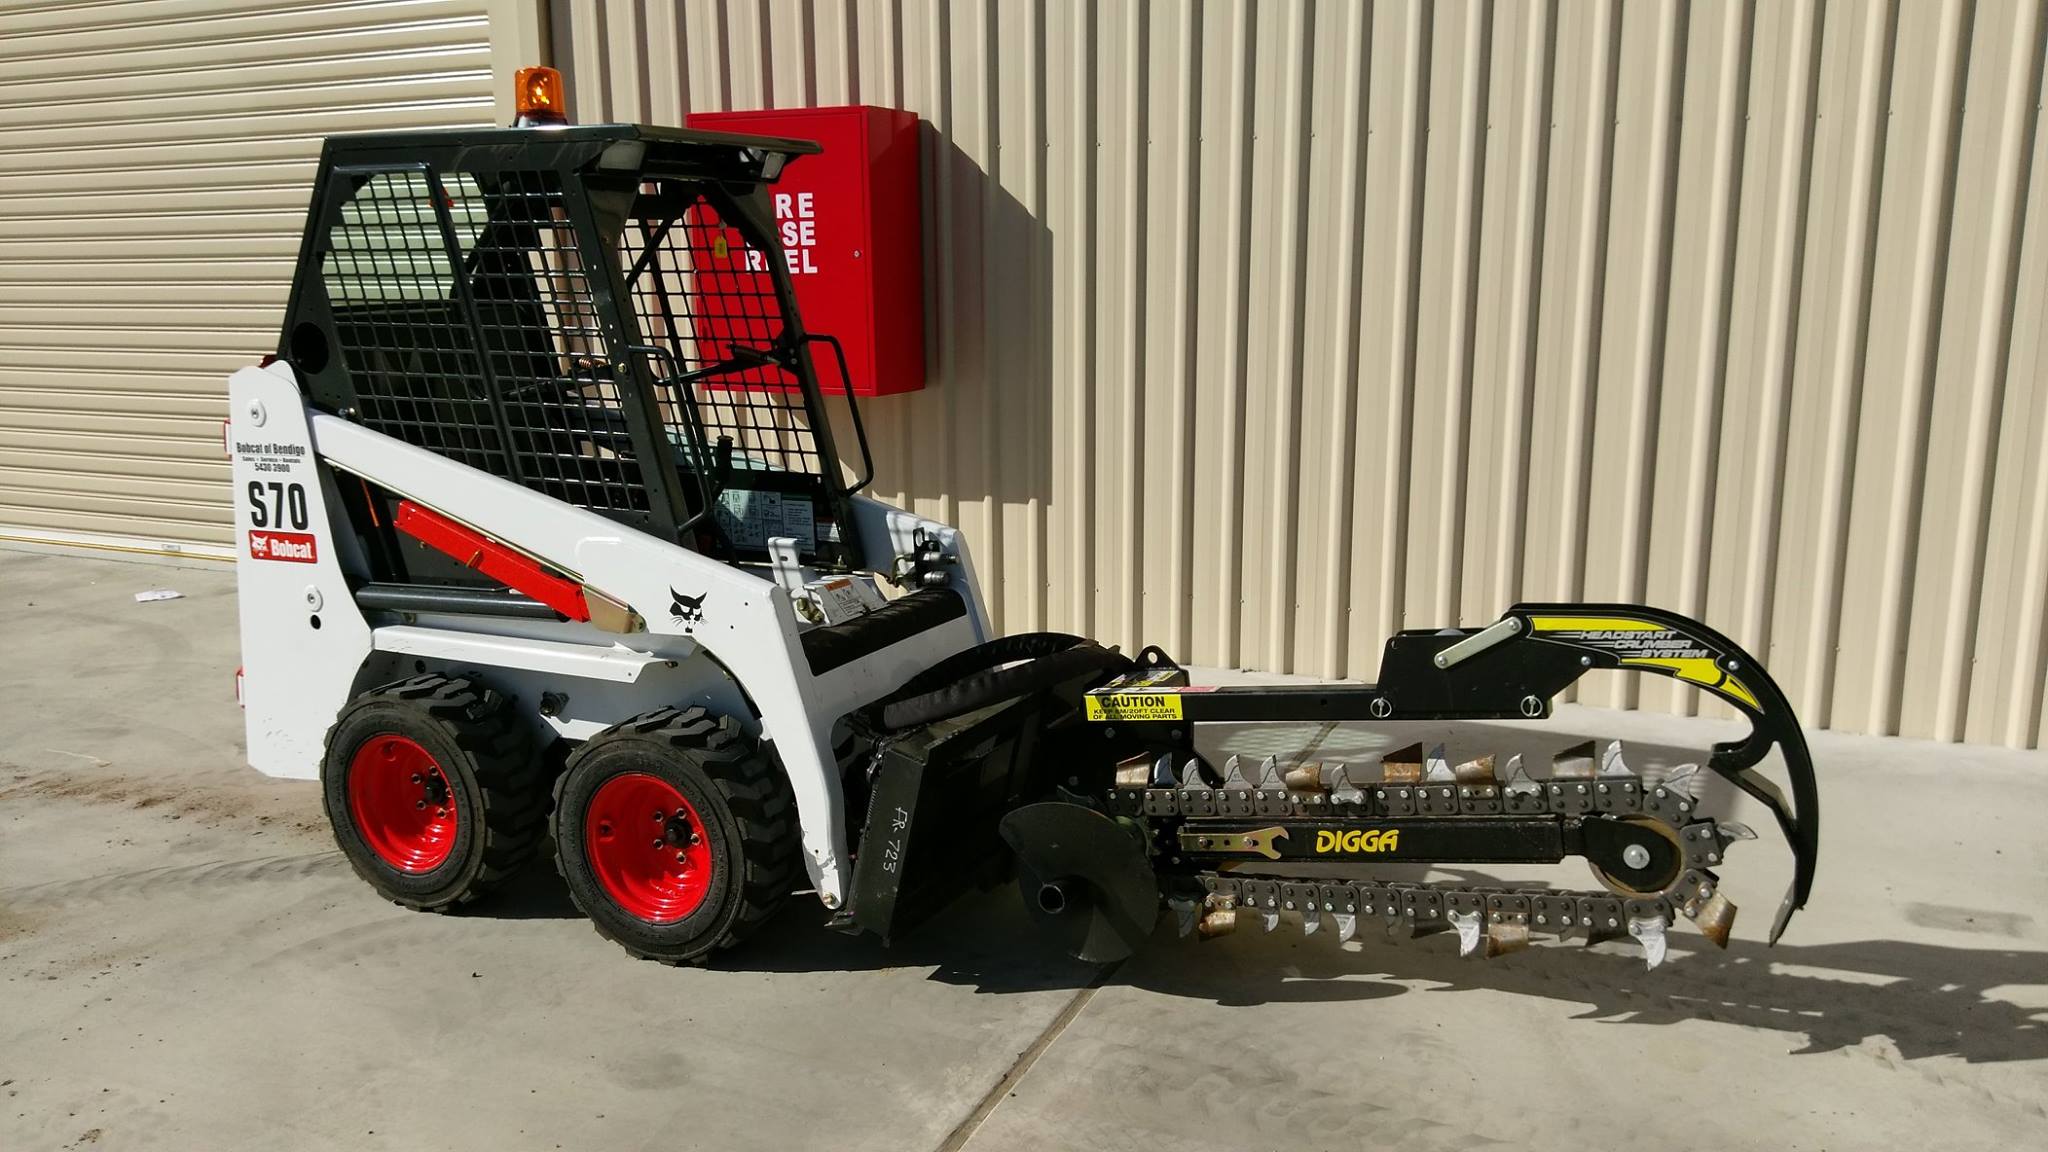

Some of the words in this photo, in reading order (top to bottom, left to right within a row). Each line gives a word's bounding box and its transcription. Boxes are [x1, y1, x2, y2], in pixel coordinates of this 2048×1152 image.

[775, 192, 815, 219] RE
[744, 248, 818, 274] REL
[236, 442, 263, 454] Bobcat
[264, 444, 272, 454] of
[273, 444, 306, 457] Bendigo
[248, 480, 309, 531] S70
[270, 539, 314, 560] Bobcat
[1580, 630, 1677, 640] HEADSTART
[1640, 649, 1708, 658] SYSTEM
[1101, 696, 1165, 708] CAUTION
[1315, 829, 1399, 853] DIGGA
